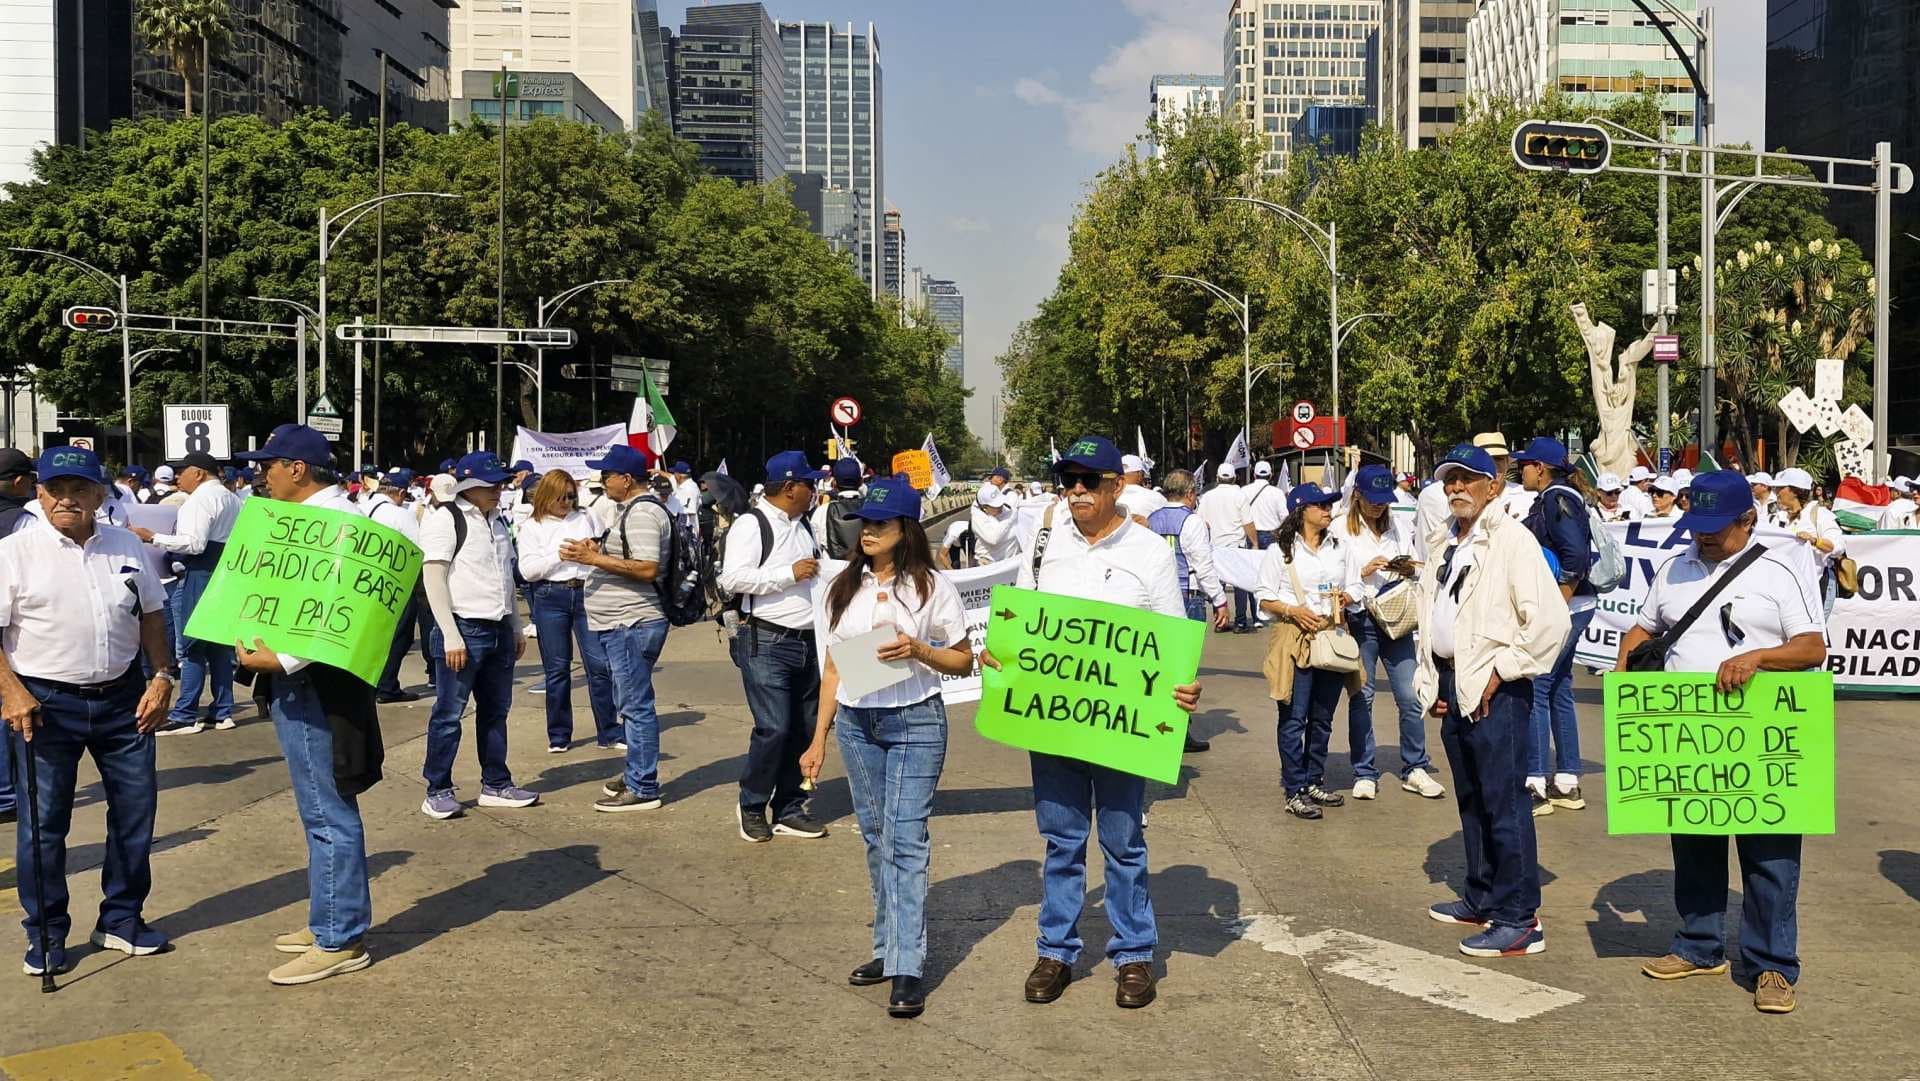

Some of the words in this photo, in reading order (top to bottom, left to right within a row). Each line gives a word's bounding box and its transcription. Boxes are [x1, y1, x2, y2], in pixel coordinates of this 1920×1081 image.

[522, 84, 563, 96] Express
[181, 409, 212, 421] BLOQUE
[184, 421, 211, 456] 8
[1069, 441, 1099, 456] CFE
[53, 453, 87, 467] CFE
[270, 515, 407, 573] SEGURIDAD
[1625, 522, 1693, 550] LA
[227, 543, 342, 585] JURÍDICA
[353, 569, 404, 614] BASE
[1857, 565, 1920, 602] OR
[240, 593, 280, 627] DEL
[295, 596, 354, 634] PAÍS
[1025, 607, 1160, 661] JUSTICIA
[1585, 627, 1626, 647] UE
[1018, 647, 1118, 687] SOCIAL
[1141, 669, 1160, 697] Y
[1826, 654, 1920, 677] BILAD
[1003, 687, 1150, 739] LABORAL
[1618, 683, 1745, 713] RESPETO
[1774, 685, 1807, 712] AL
[1617, 721, 1746, 755] ESTADO
[1763, 726, 1800, 753] DE
[1617, 761, 1751, 792] DERECHO
[1766, 762, 1799, 787] DE
[1656, 793, 1786, 827] TODOS
